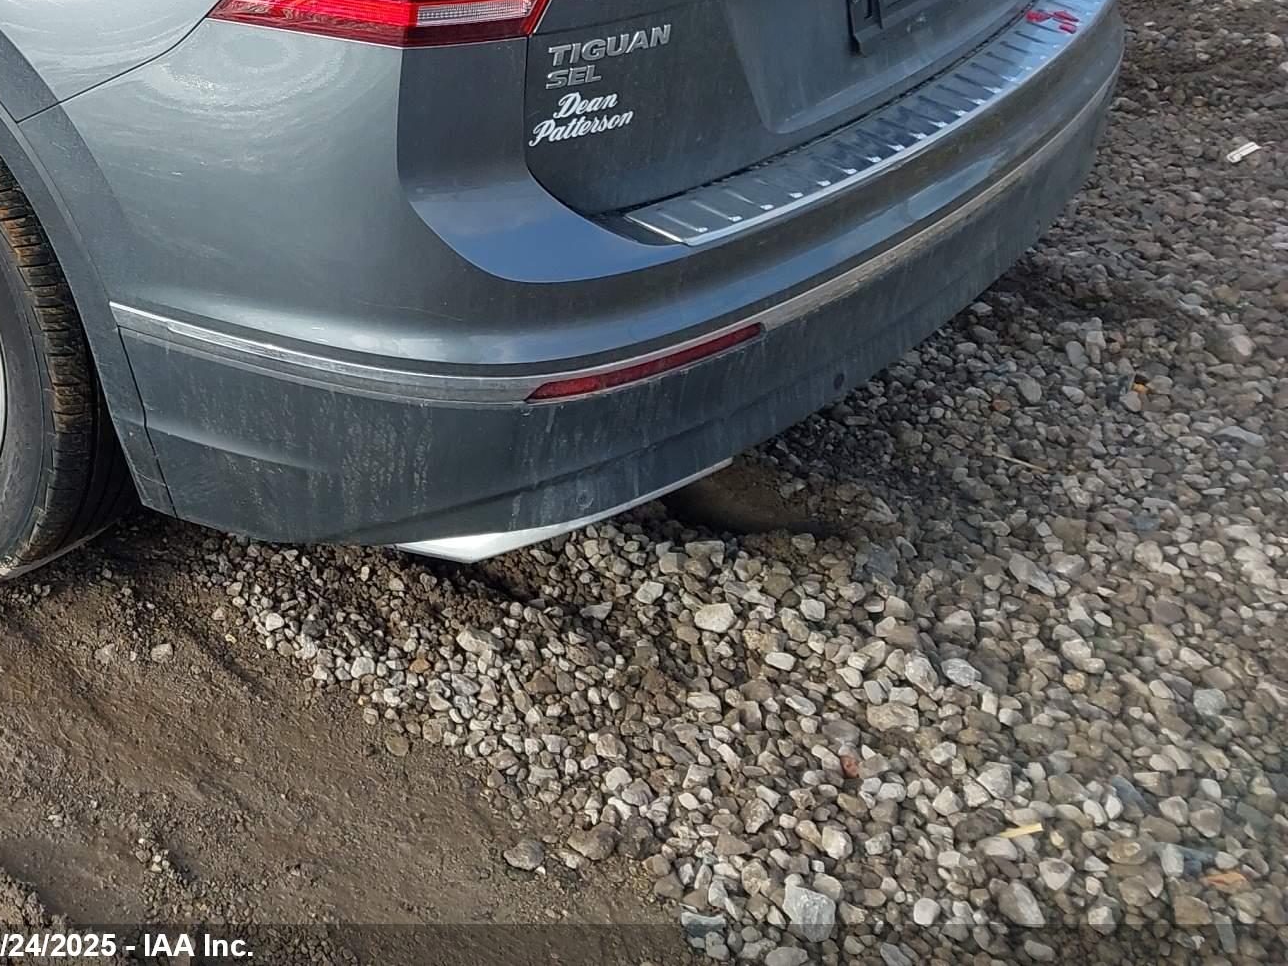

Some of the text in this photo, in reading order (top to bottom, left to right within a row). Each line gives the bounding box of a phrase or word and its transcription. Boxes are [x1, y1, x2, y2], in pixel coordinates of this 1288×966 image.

[548, 24, 672, 67] TIGUAN
[545, 64, 602, 90] SEL
[552, 91, 618, 119] Dean
[528, 110, 634, 147] Patterson
